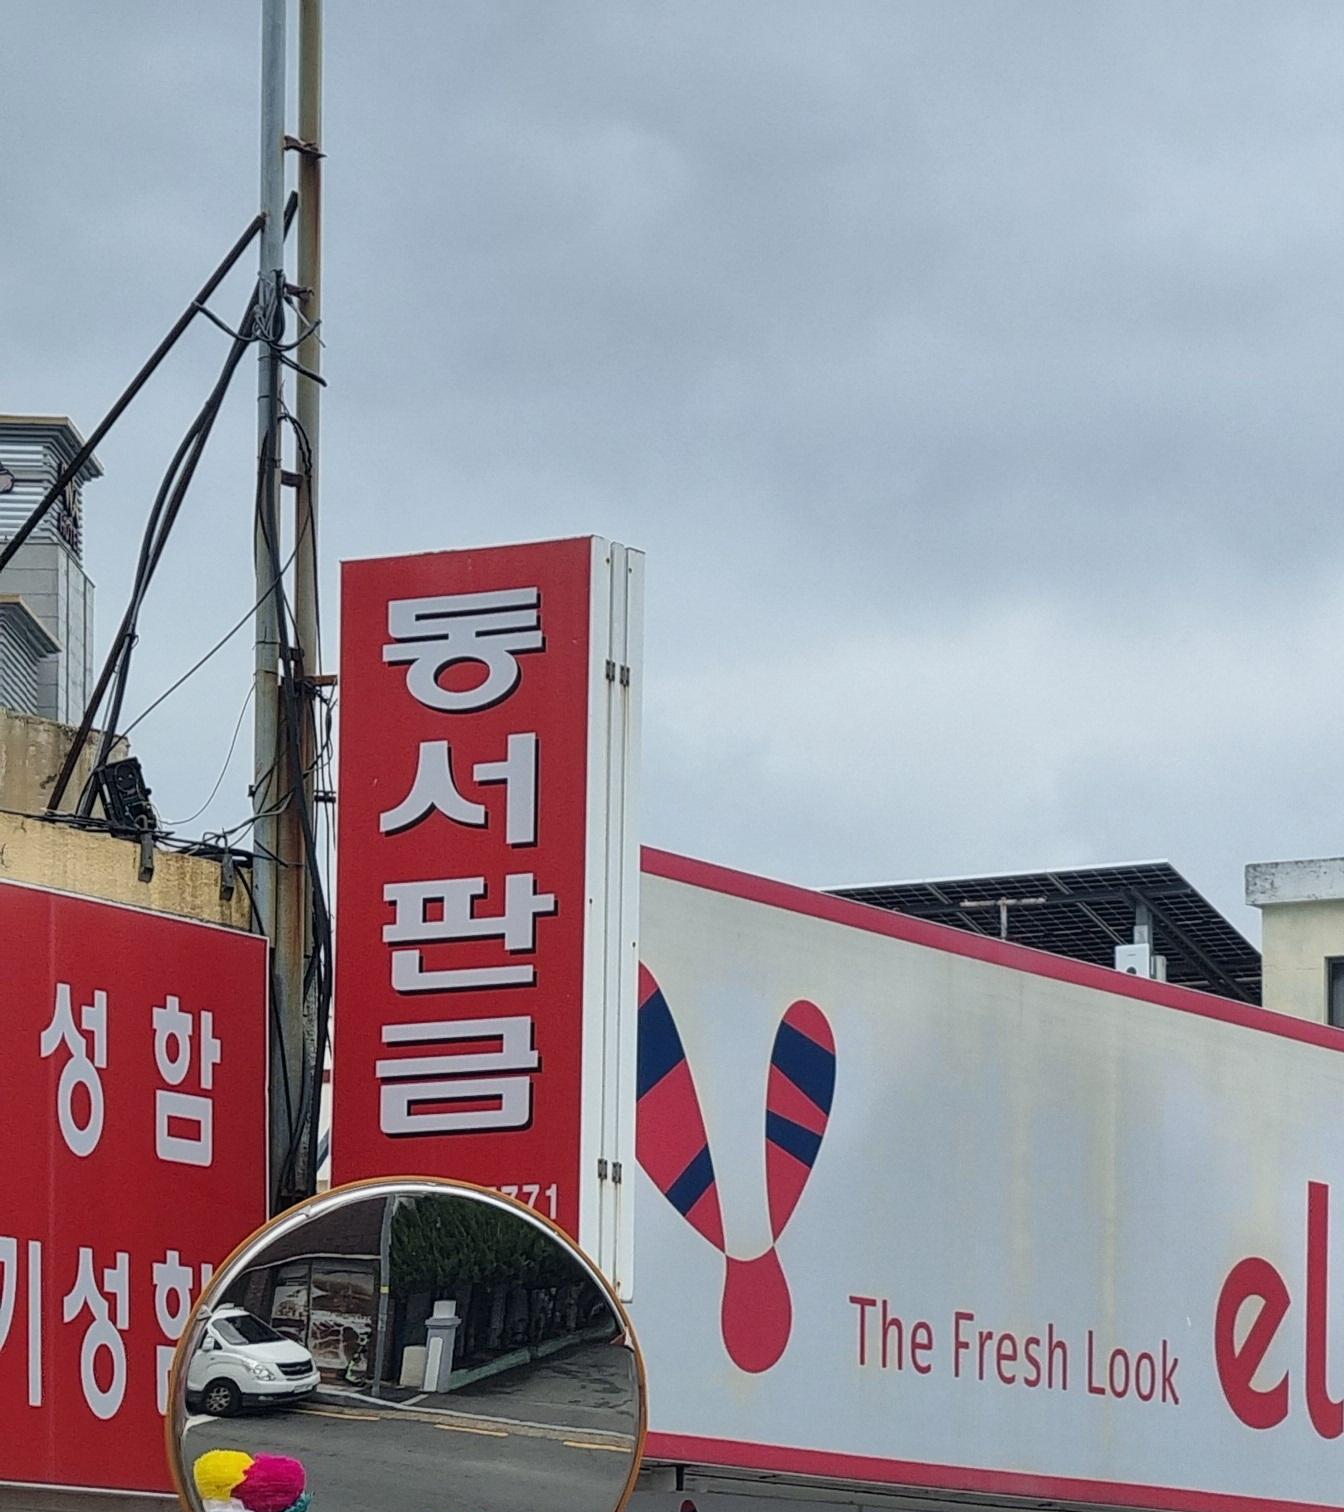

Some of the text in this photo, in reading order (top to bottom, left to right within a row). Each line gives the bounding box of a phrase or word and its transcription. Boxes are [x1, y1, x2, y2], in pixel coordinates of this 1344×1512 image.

[376, 587, 556, 1138] 동서판금
[848, 1293, 1181, 1407] The Fresh Look
